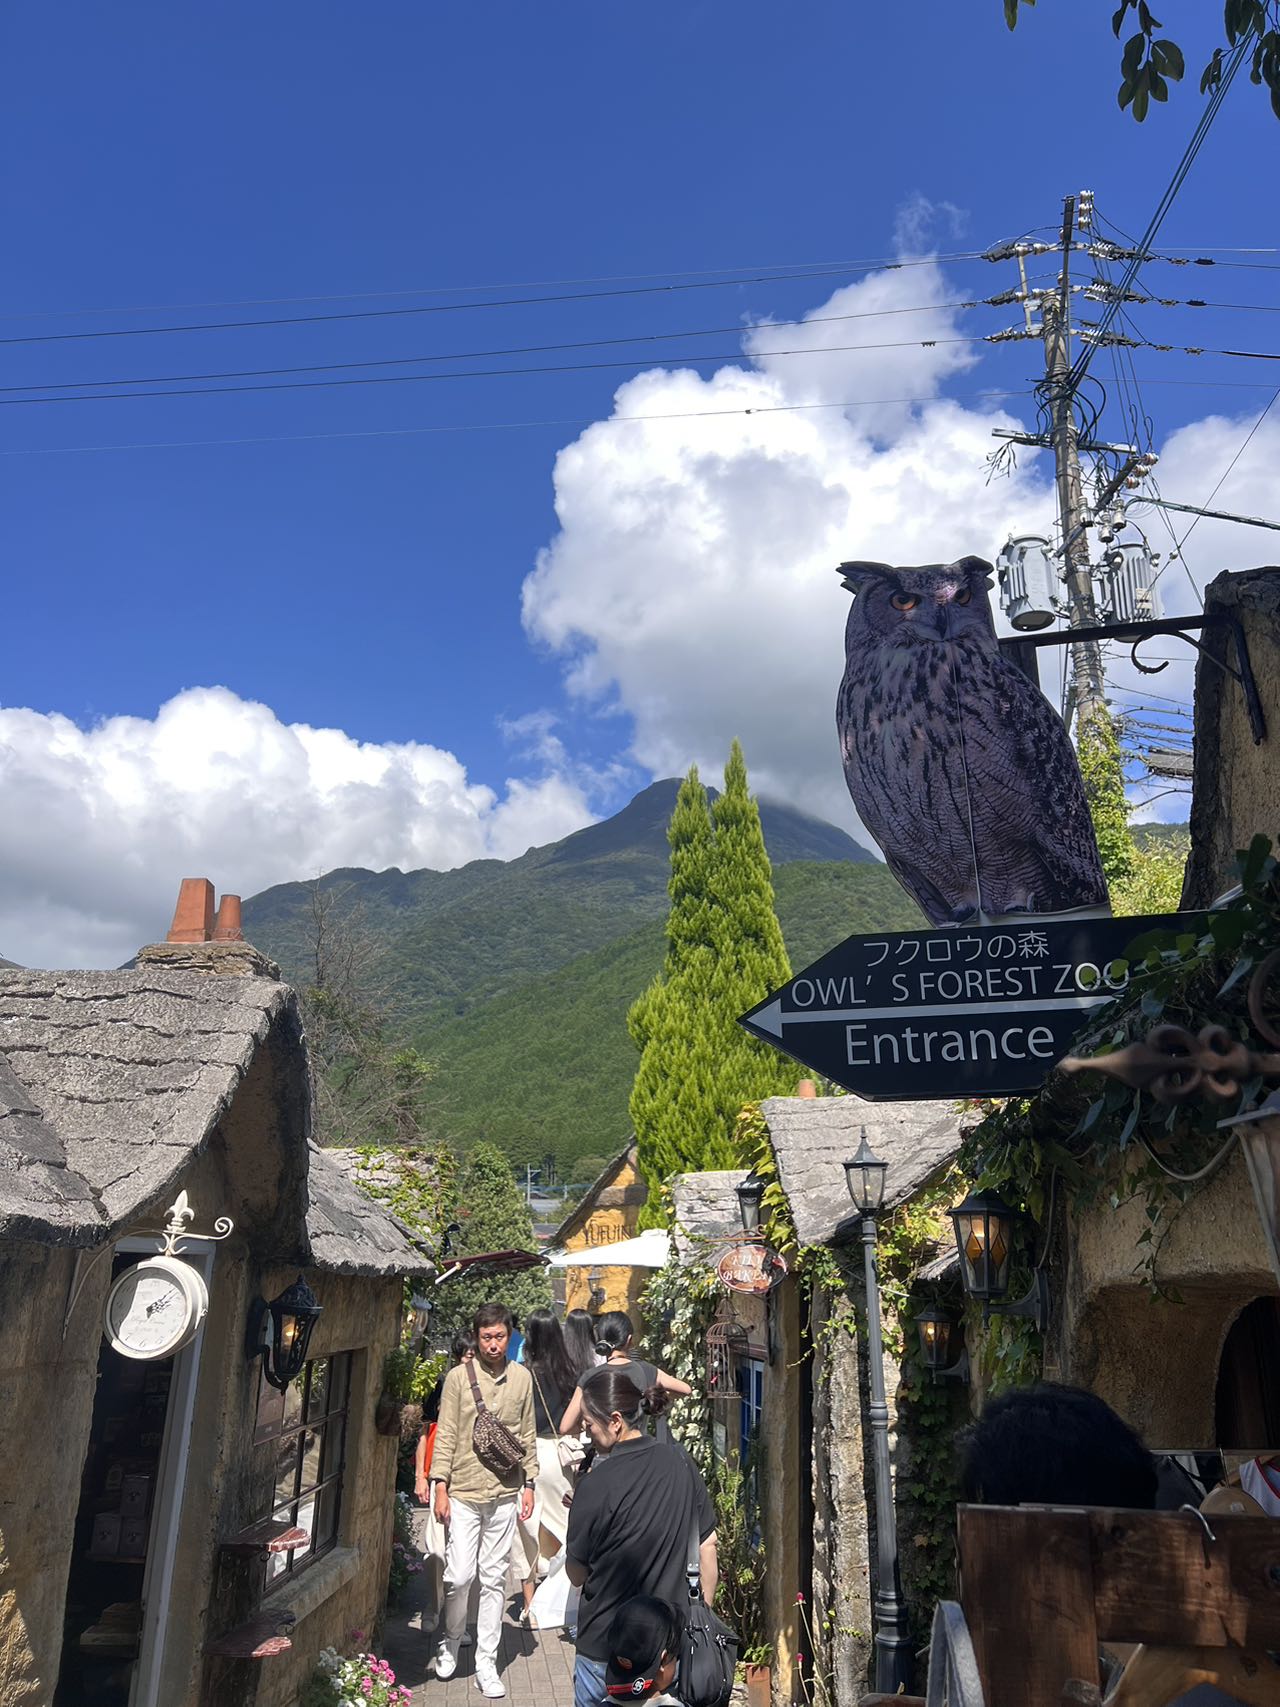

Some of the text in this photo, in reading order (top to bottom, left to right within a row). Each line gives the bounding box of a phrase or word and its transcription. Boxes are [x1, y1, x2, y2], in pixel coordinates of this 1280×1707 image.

[863, 930, 1050, 968] フクロウの森
[920, 966, 1042, 1000] FOREST
[845, 1023, 1055, 1066] Entrance
